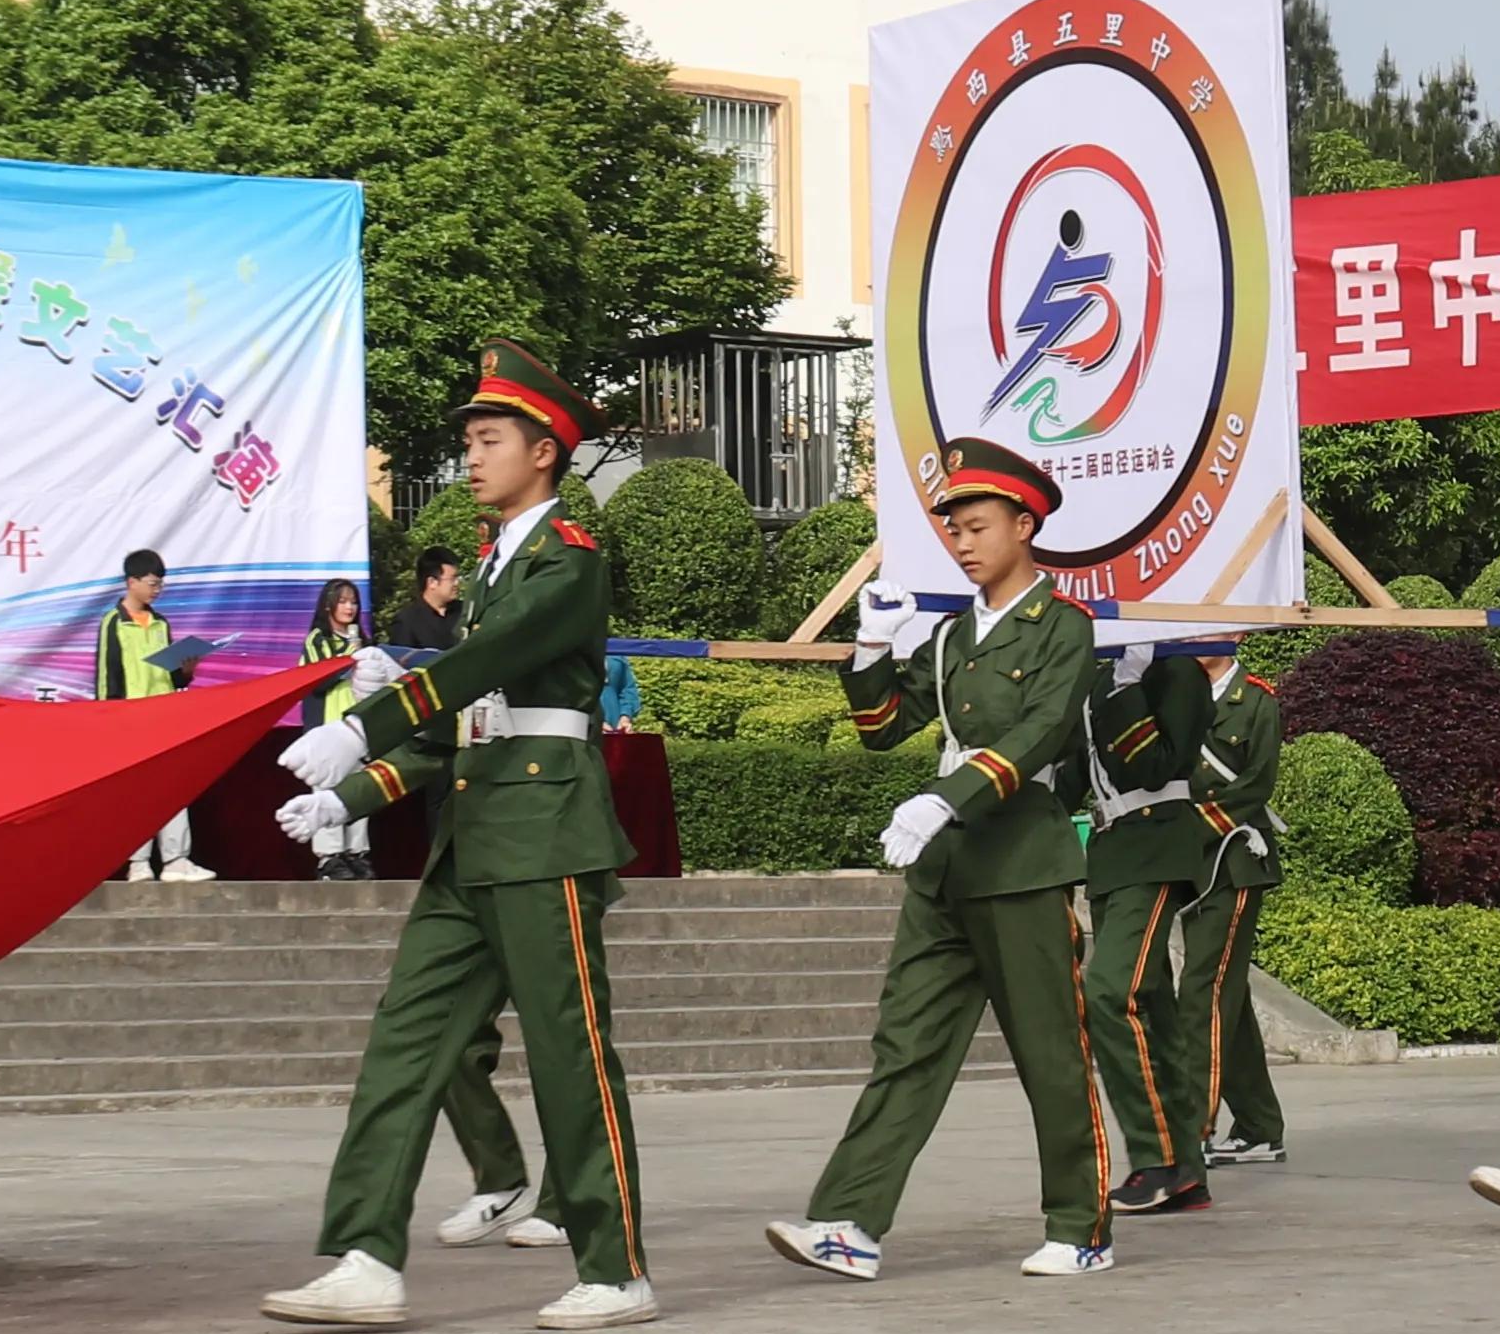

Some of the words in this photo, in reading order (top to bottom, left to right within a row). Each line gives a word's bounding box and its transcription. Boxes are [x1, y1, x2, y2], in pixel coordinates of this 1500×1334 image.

[1030, 442, 1176, 483] 第十三届田径运动会
[1134, 491, 1214, 582] Zhong
[1209, 412, 1245, 487] xue
